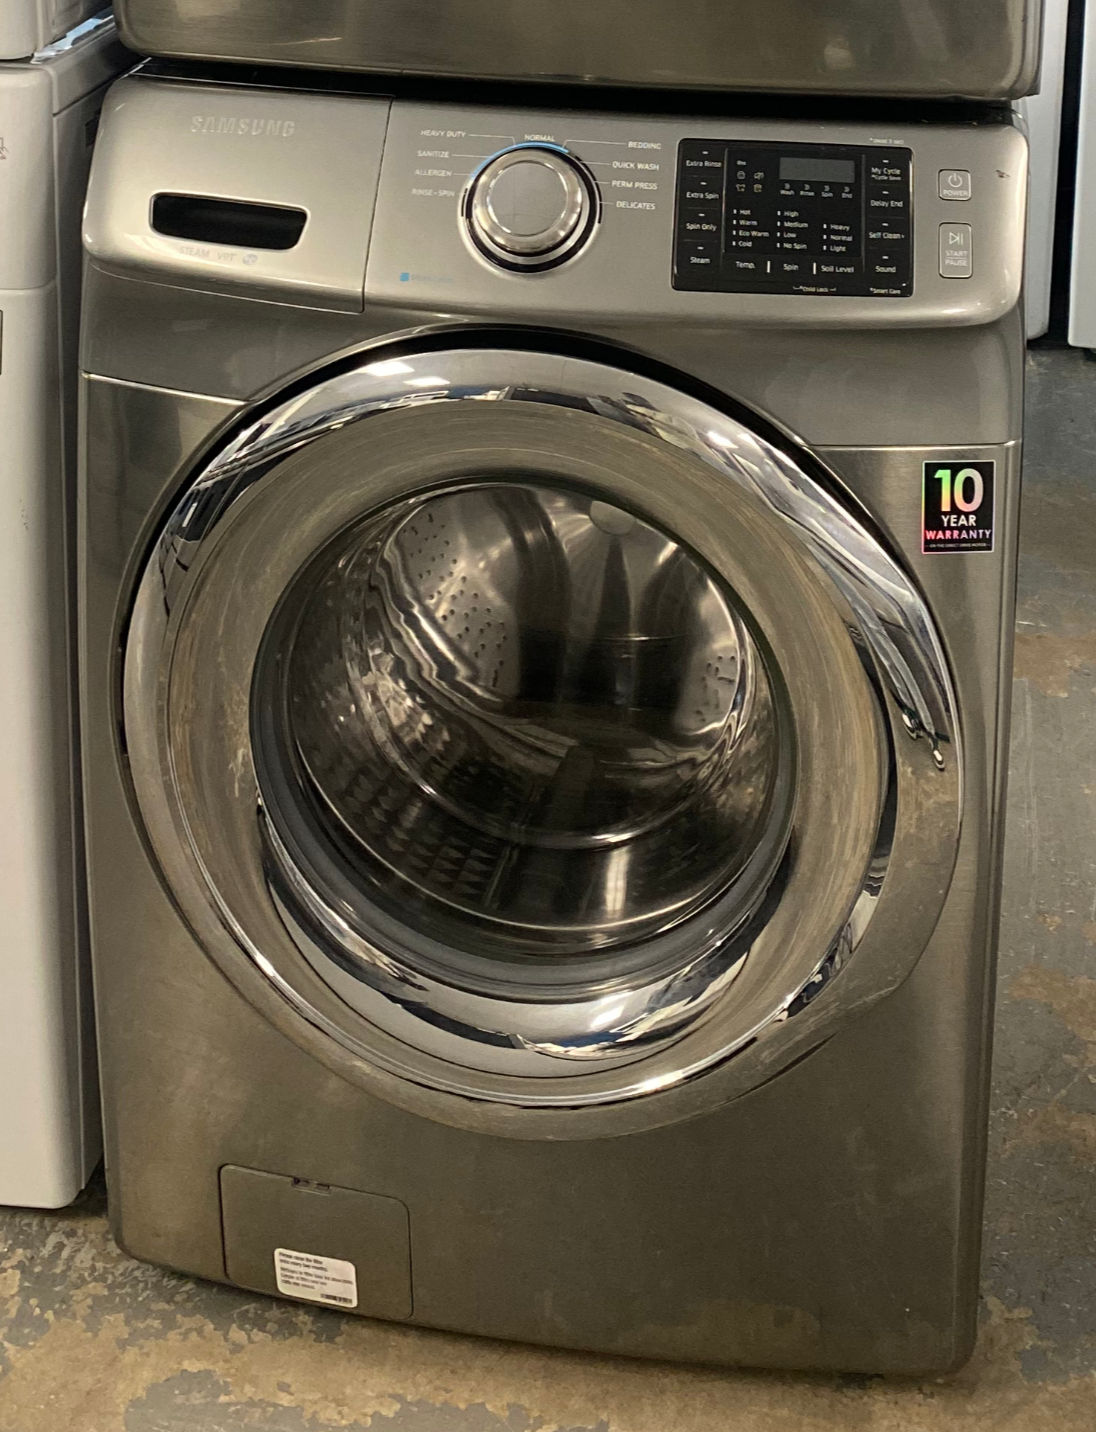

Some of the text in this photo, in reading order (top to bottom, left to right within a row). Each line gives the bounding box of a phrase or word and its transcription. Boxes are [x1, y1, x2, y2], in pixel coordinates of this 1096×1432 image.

[191, 115, 296, 137] SAMSUNG
[420, 129, 467, 138] HEAVY DUTY
[524, 134, 555, 142] NORMAL
[628, 141, 661, 149] BEDDING
[417, 150, 449, 158] SANITIZE
[612, 161, 659, 171] QUICK WASH
[704, 160, 722, 168] Rinse
[415, 169, 452, 177] ALLERGEN
[611, 180, 658, 190] PERM PRESS
[616, 200, 656, 210] DELICATES
[870, 200, 889, 208] Delay
[702, 223, 717, 232] Only
[180, 246, 210, 258] STEAM
[783, 263, 799, 271] Spin
[821, 265, 834, 273] Soil
[934, 468, 984, 513] 10
[941, 514, 977, 527] YEAR
[925, 528, 992, 540] WARRANTY
